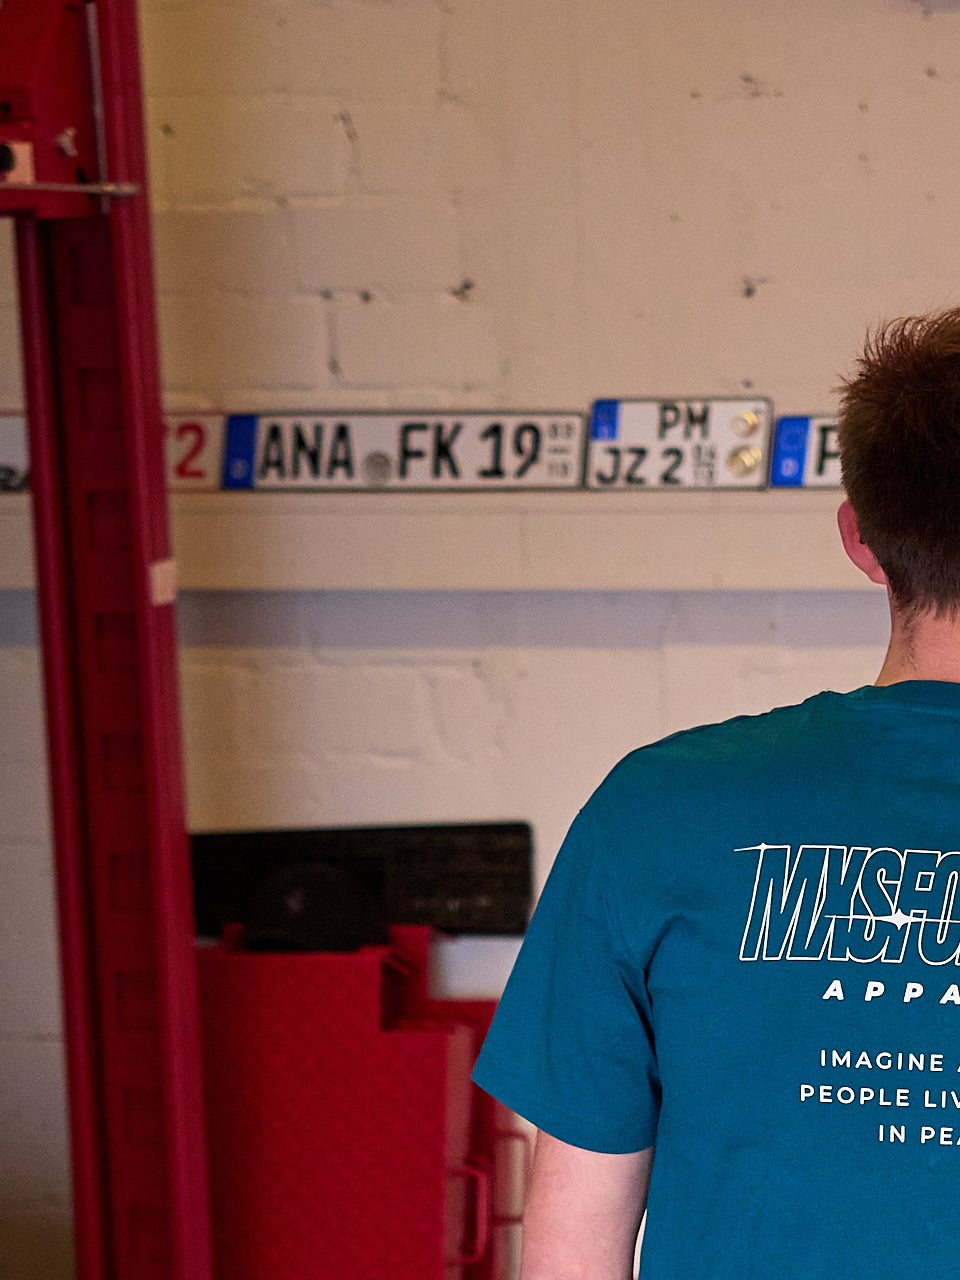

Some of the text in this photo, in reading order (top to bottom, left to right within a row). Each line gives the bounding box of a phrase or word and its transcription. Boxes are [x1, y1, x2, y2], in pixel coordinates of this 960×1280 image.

[657, 403, 710, 440] PM
[259, 423, 354, 479] ANA
[396, 423, 463, 479] FK
[477, 423, 542, 479] 19
[595, 446, 648, 486] JZ
[820, 1049, 944, 1072] IMAGINE
[800, 1084, 910, 1107] PEOPLE
[878, 1124, 906, 1143] IN
